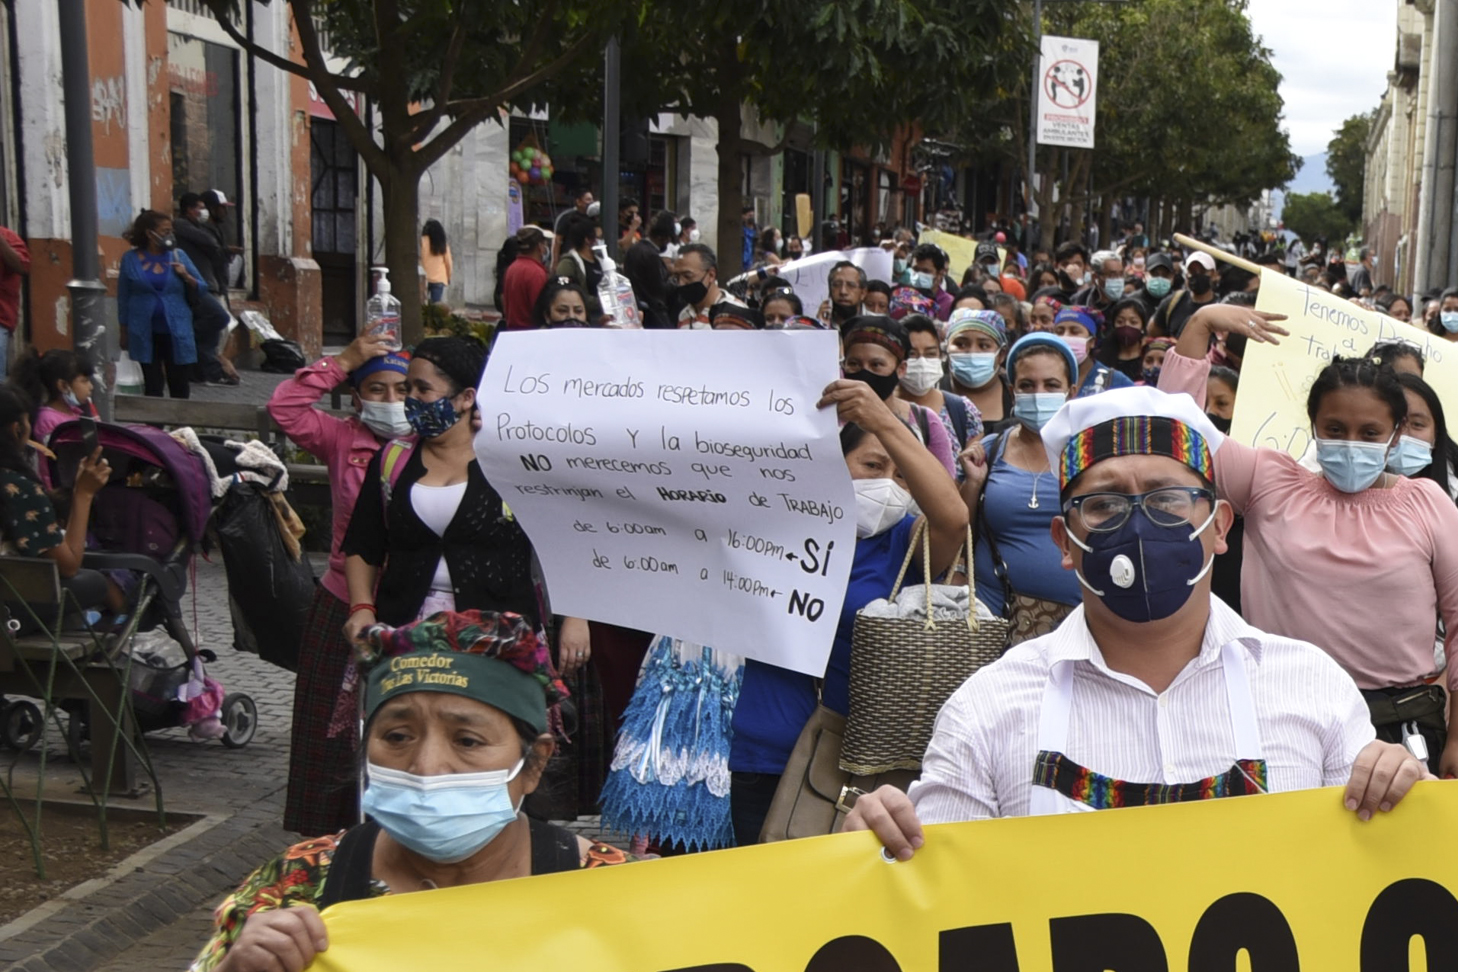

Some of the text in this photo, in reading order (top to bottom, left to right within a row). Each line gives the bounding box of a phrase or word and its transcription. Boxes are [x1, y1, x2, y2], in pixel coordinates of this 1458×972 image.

[563, 376, 645, 399] mercados
[657, 383, 750, 408] respetamos
[768, 389, 795, 416] los
[496, 412, 597, 446] Protocolos
[661, 425, 681, 451] la
[695, 431, 813, 463] bioseguridad
[520, 453, 796, 483] NO merecemos que nos
[616, 486, 636, 500] el
[748, 491, 771, 509] de
[573, 519, 598, 533] de
[694, 528, 708, 543] a
[592, 548, 612, 570] de
[700, 567, 709, 580] a
[787, 589, 825, 622] NO
